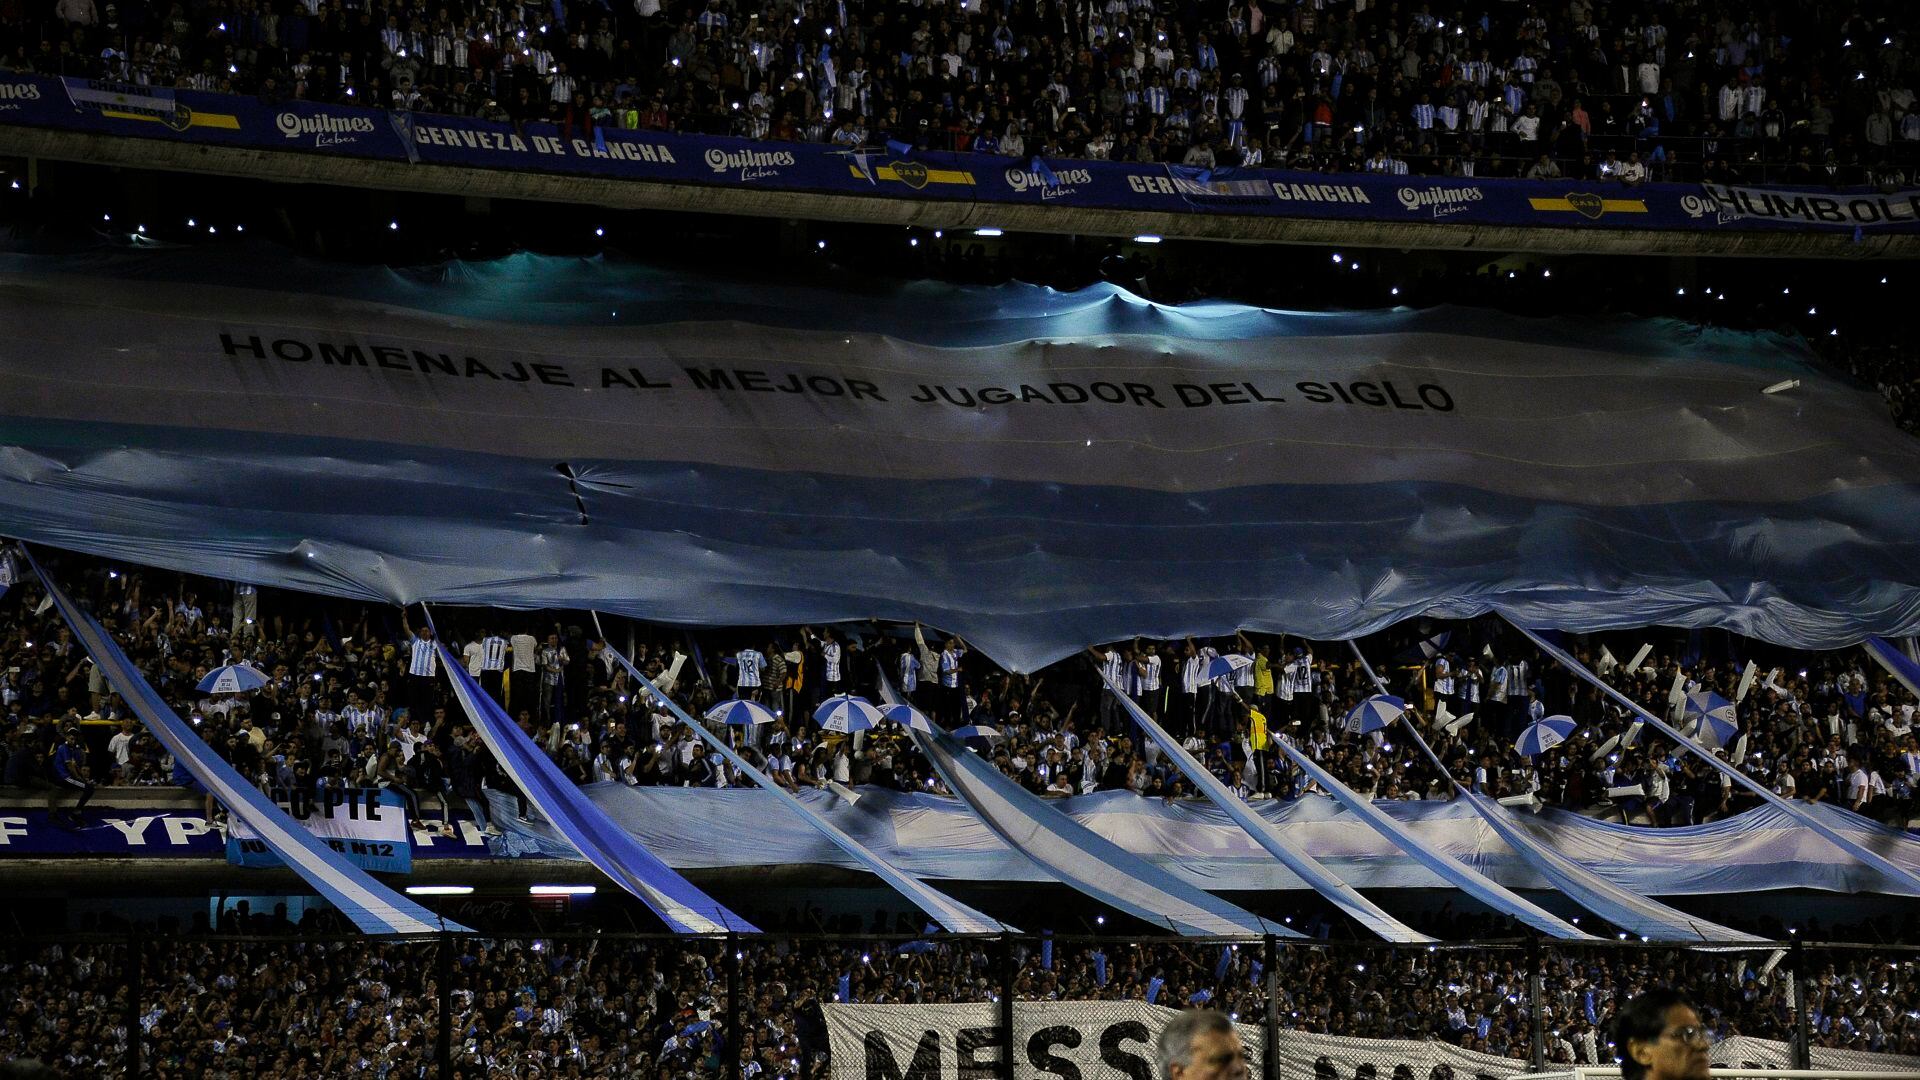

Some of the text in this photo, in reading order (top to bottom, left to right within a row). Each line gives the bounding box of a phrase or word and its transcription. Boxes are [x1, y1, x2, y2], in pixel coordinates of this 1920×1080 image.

[276, 112, 374, 138] Quilmes
[315, 132, 357, 147] Lieber
[415, 125, 528, 152] CERVEZA
[531, 135, 566, 155] DE
[704, 148, 795, 173] Quilmes
[741, 167, 778, 181] Lieber
[1005, 168, 1092, 192] Qumes
[1272, 182, 1371, 204] CANCHA
[1397, 186, 1483, 210] Quilmes
[219, 333, 1454, 412] HOMENAJE AL MEJOR JUGADOR DEL SIGLO
[742, 659, 754, 673] 12
[324, 788, 381, 821] PTE
